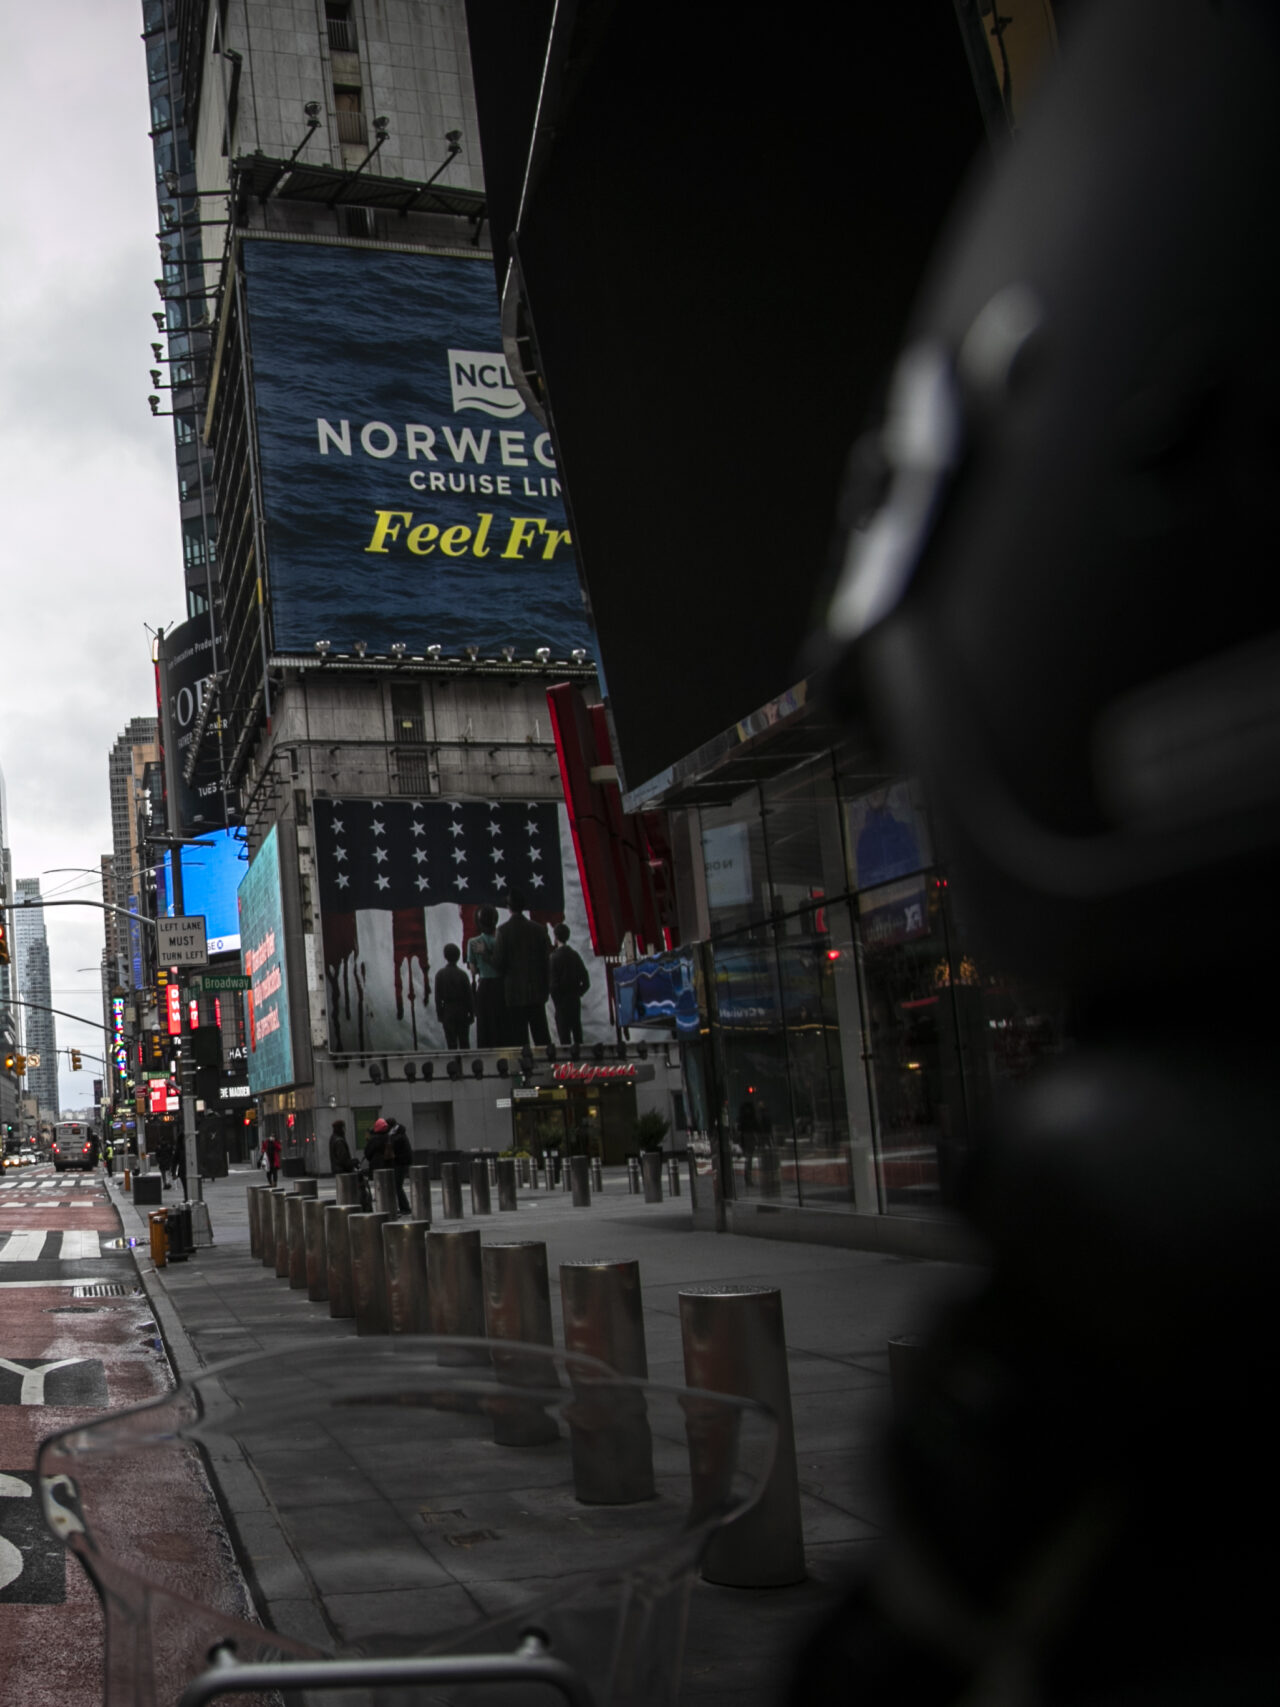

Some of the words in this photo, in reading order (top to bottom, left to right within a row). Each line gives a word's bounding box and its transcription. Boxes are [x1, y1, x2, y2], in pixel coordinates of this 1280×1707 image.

[317, 418, 556, 469] NORWEG
[409, 471, 512, 496] CRUISE
[364, 510, 494, 559] Feel
[500, 517, 572, 561] Fr
[160, 922, 178, 932] LEFT
[182, 921, 201, 931] LANE
[169, 936, 194, 946] MUST
[162, 952, 182, 961] TURN
[186, 950, 204, 960] LEFT
[204, 978, 249, 990] Broadway
[552, 1062, 638, 1084] Walgreens
